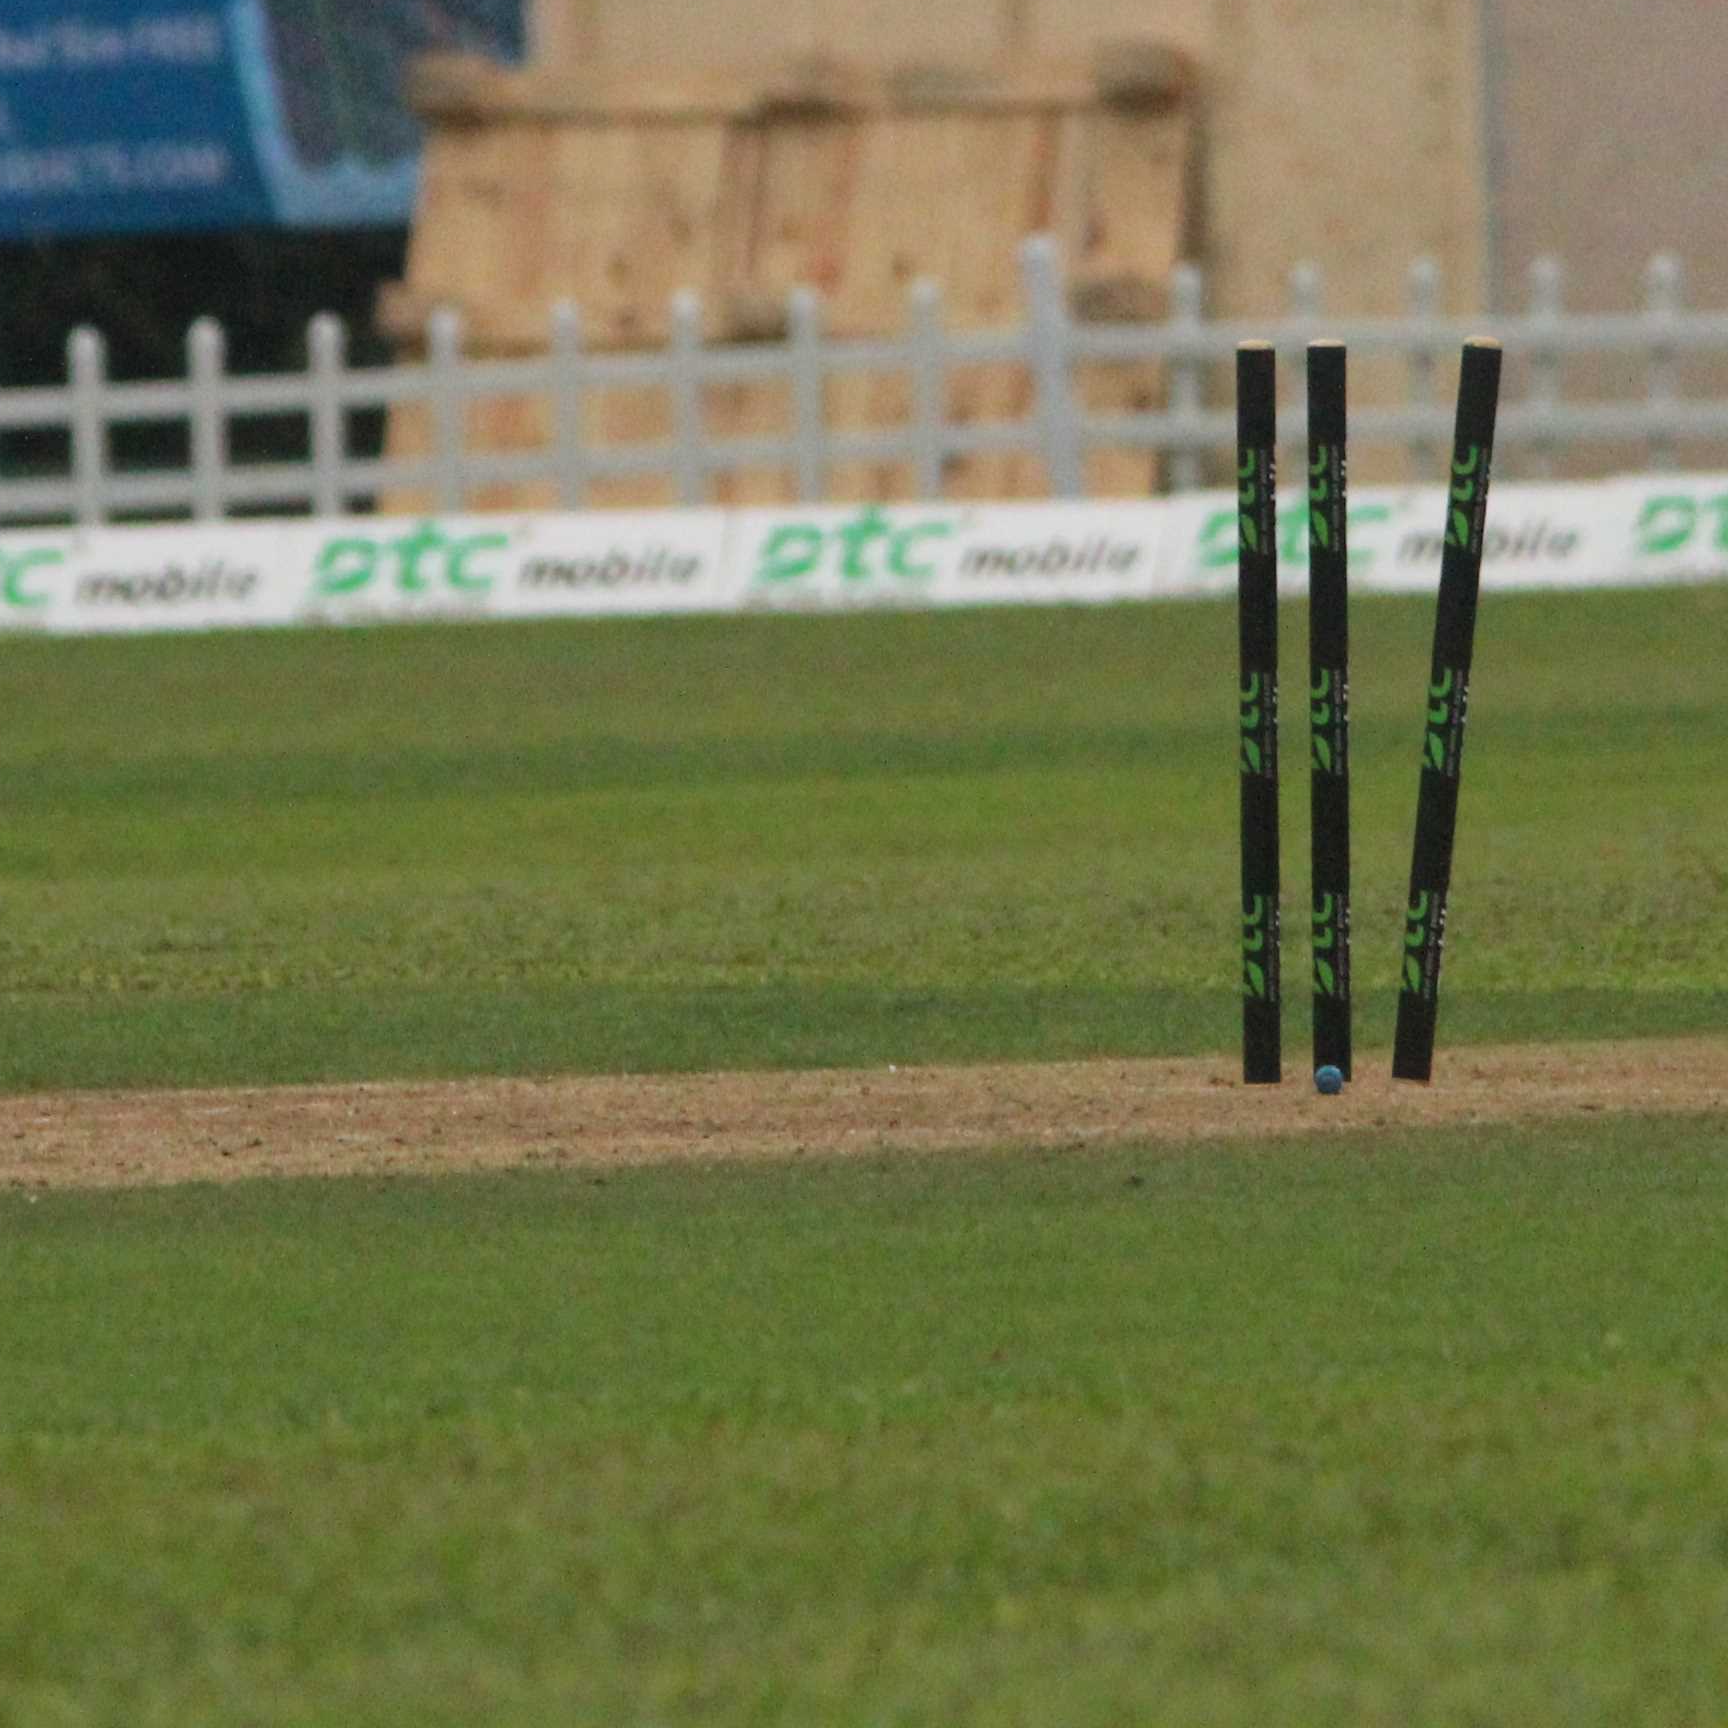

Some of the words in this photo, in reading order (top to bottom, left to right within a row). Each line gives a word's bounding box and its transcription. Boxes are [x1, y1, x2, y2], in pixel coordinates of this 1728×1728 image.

[518, 541, 703, 590] mobile
[958, 536, 1142, 579] mobile
[76, 563, 260, 608] mobile
